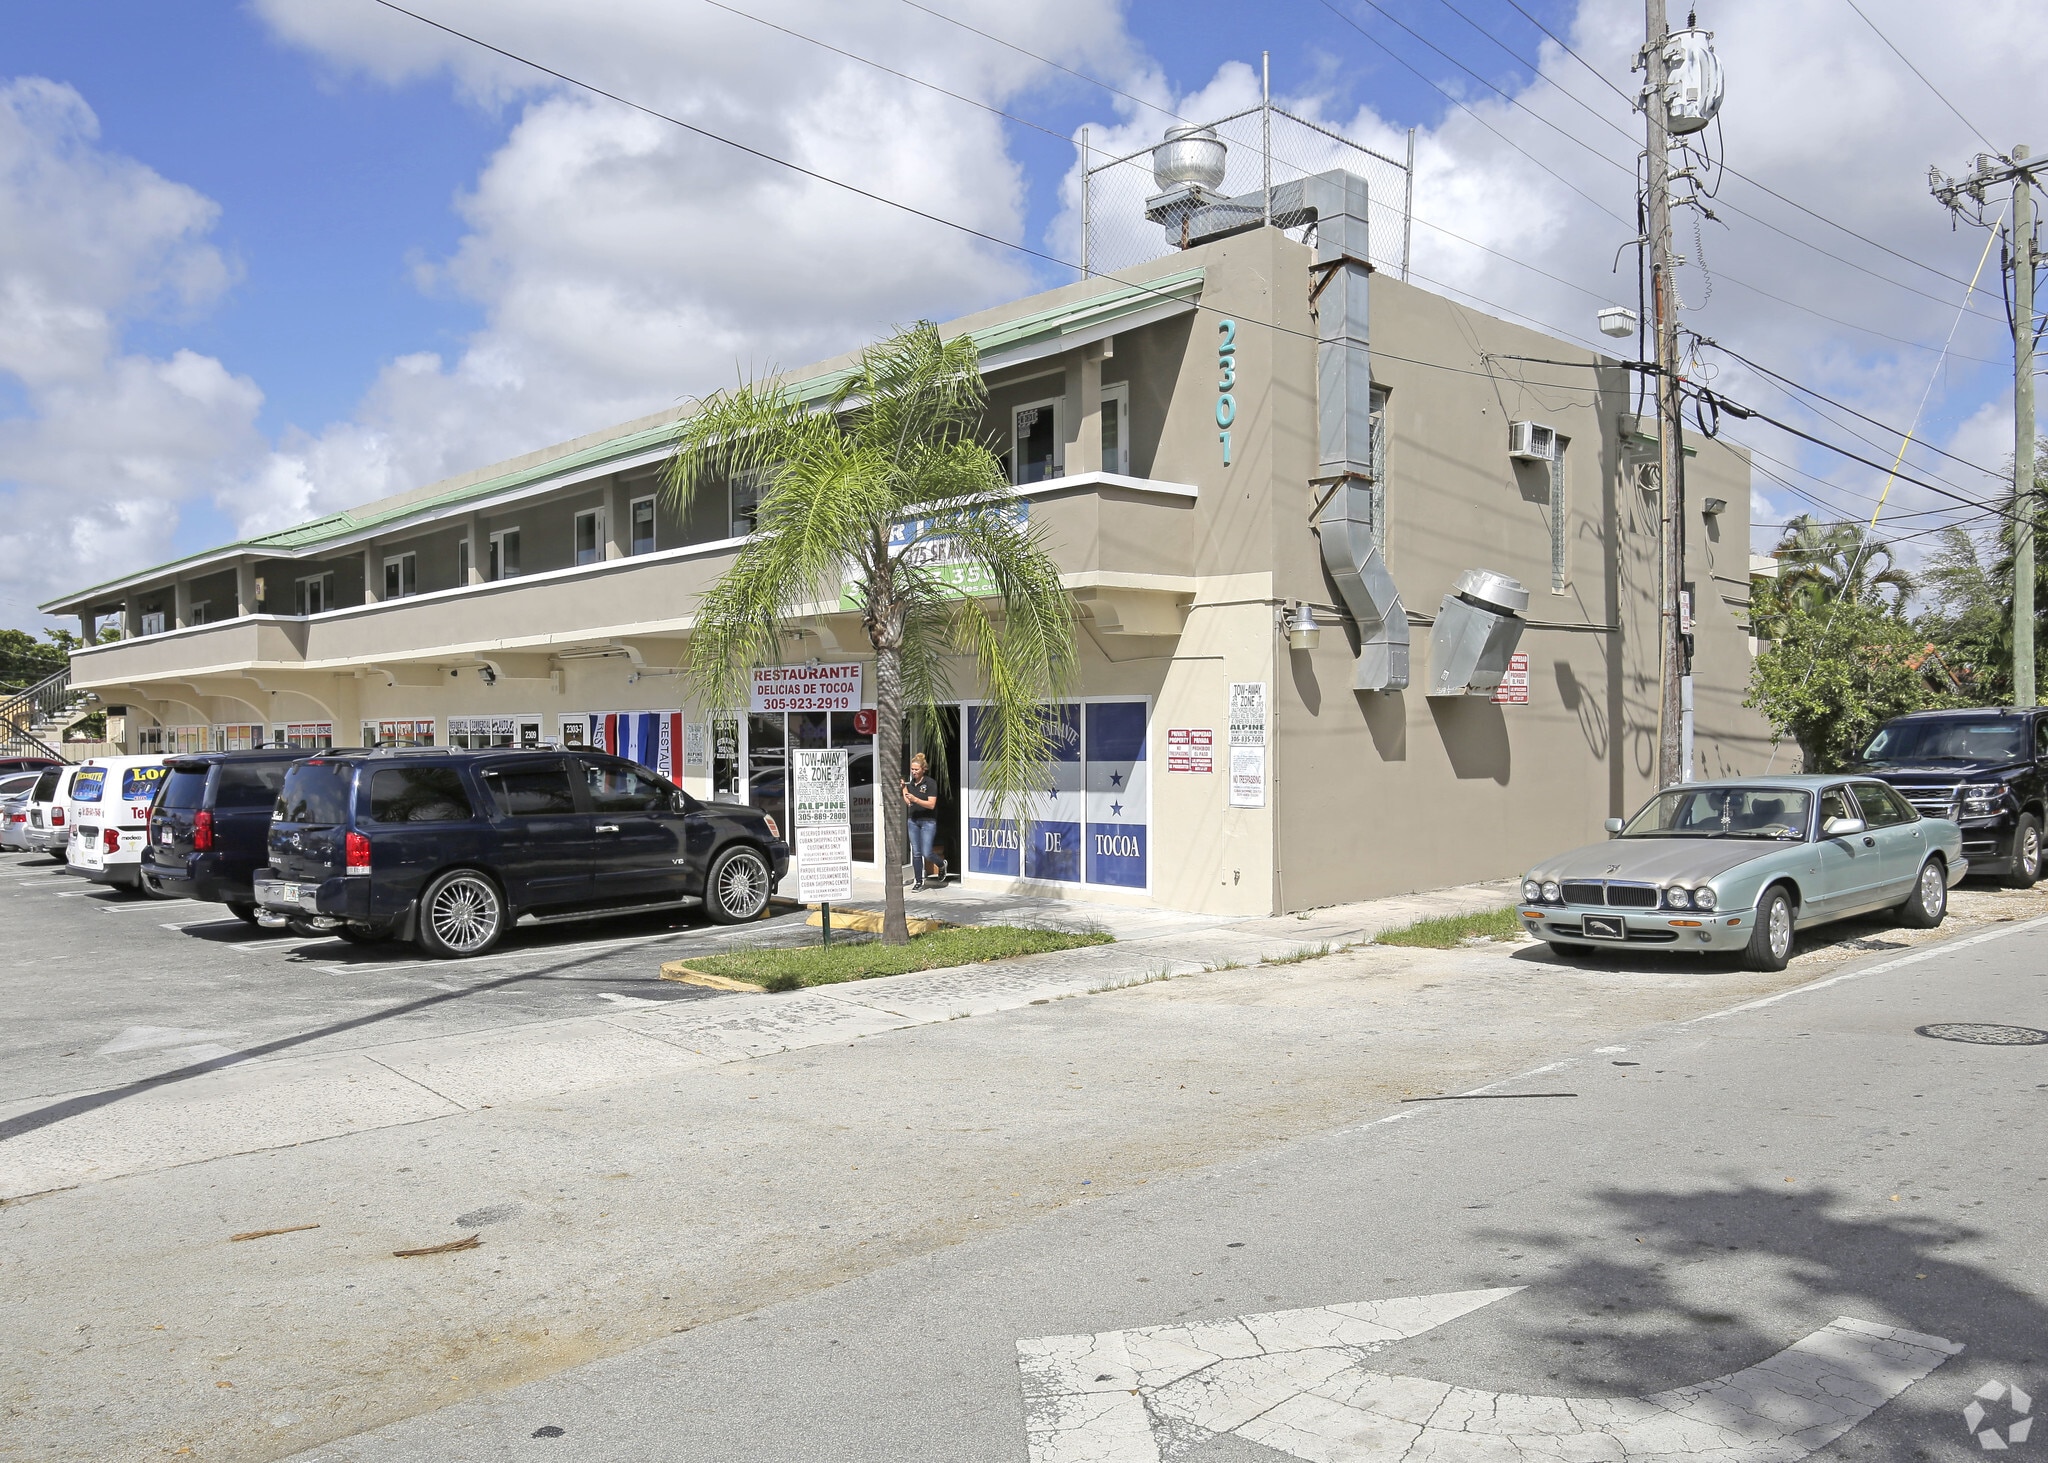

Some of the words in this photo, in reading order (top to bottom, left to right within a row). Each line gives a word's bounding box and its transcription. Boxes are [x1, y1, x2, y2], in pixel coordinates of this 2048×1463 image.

[1216, 319, 1236, 465] 2301
[754, 666, 859, 682] RESTAURANTE
[757, 684, 800, 695] DELICIAS
[803, 684, 817, 694] DE
[819, 682, 855, 693] TOCOA
[763, 697, 849, 710] 305-923-2919
[1240, 695, 1255, 707] ZONE
[525, 731, 537, 739] 2309
[566, 724, 583, 733] 2303-7
[800, 753, 840, 767] TOW-AWAY
[799, 767, 806, 775] 24
[811, 767, 832, 781] ZONE
[798, 802, 846, 810] ALPINE
[971, 827, 1018, 850] DELICIAS
[1045, 832, 1061, 852] DE
[1095, 834, 1140, 857] TOCOA
